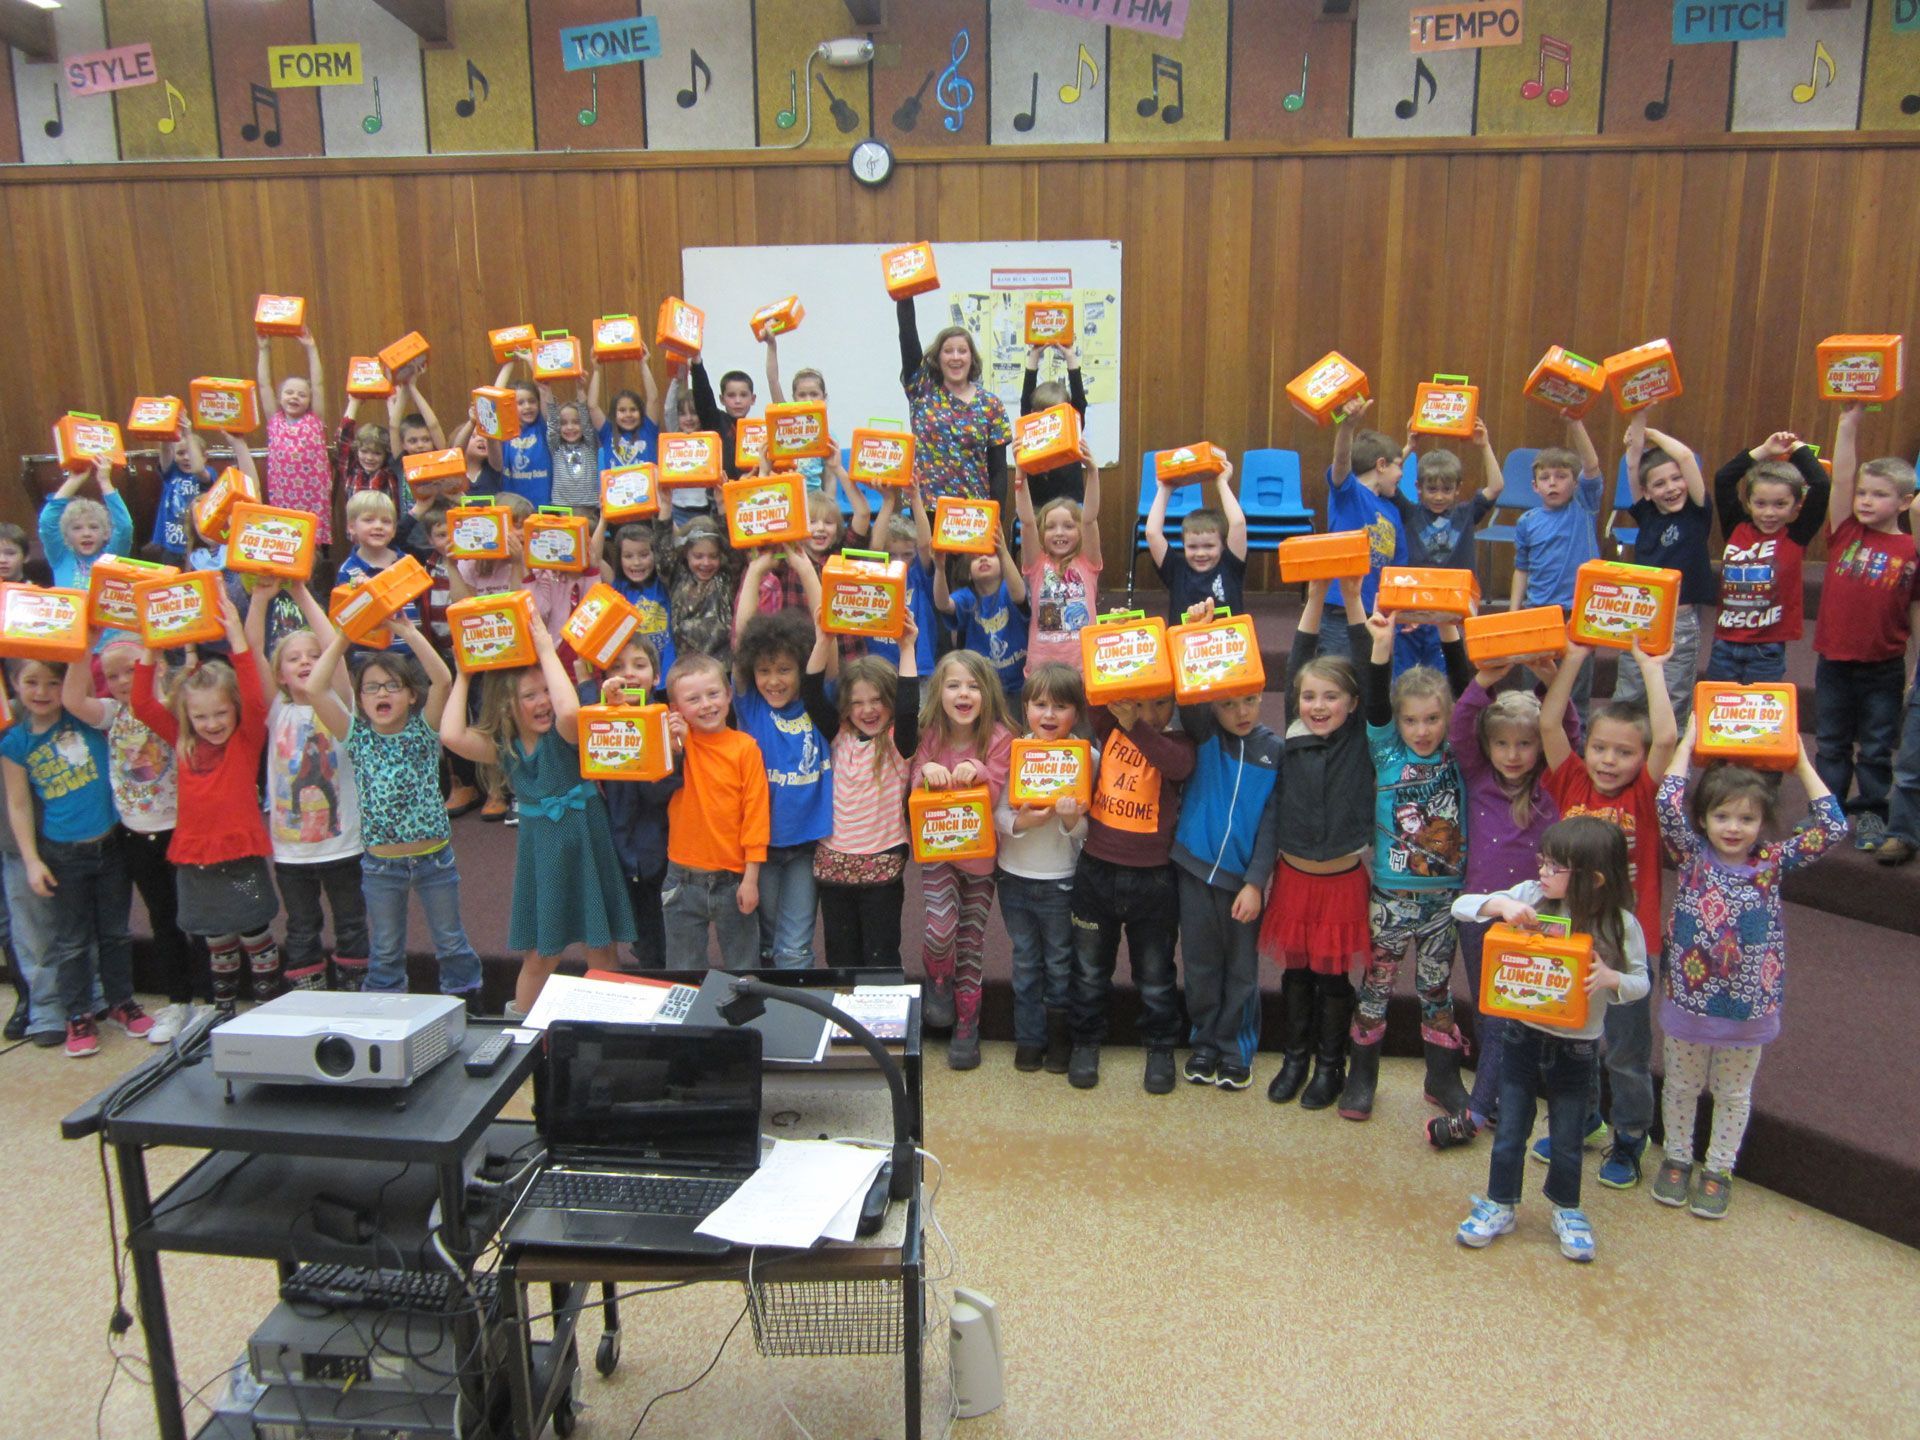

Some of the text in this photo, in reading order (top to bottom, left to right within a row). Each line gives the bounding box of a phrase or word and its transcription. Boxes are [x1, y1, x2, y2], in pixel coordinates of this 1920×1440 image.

[1413, 9, 1519, 42] TEMPO
[1684, 2, 1784, 34] PITCH
[571, 27, 650, 61] TONE
[70, 52, 152, 88] STYLE
[279, 52, 352, 79] FORM
[745, 434, 767, 443] LUNC
[738, 507, 786, 523] LUNCH BOX
[240, 534, 297, 554] LUNCH BOX
[151, 596, 201, 615] LUNCH BOX
[836, 595, 890, 608] LUNCH BOX
[1589, 595, 1656, 617] LUNCH BOX
[1718, 605, 1782, 628] RESCUE
[465, 626, 513, 641] LUNCH BOX
[1098, 643, 1155, 660] LUNCH BOX
[1188, 640, 1245, 659] LUNCH BOX
[1713, 707, 1783, 720] LUNCH BOX
[592, 735, 641, 747] LUNCH BOX
[1024, 762, 1079, 774] LUNCH BOX
[926, 818, 980, 833] LUNCH BOX
[1499, 967, 1570, 989] LUNCH BOX
